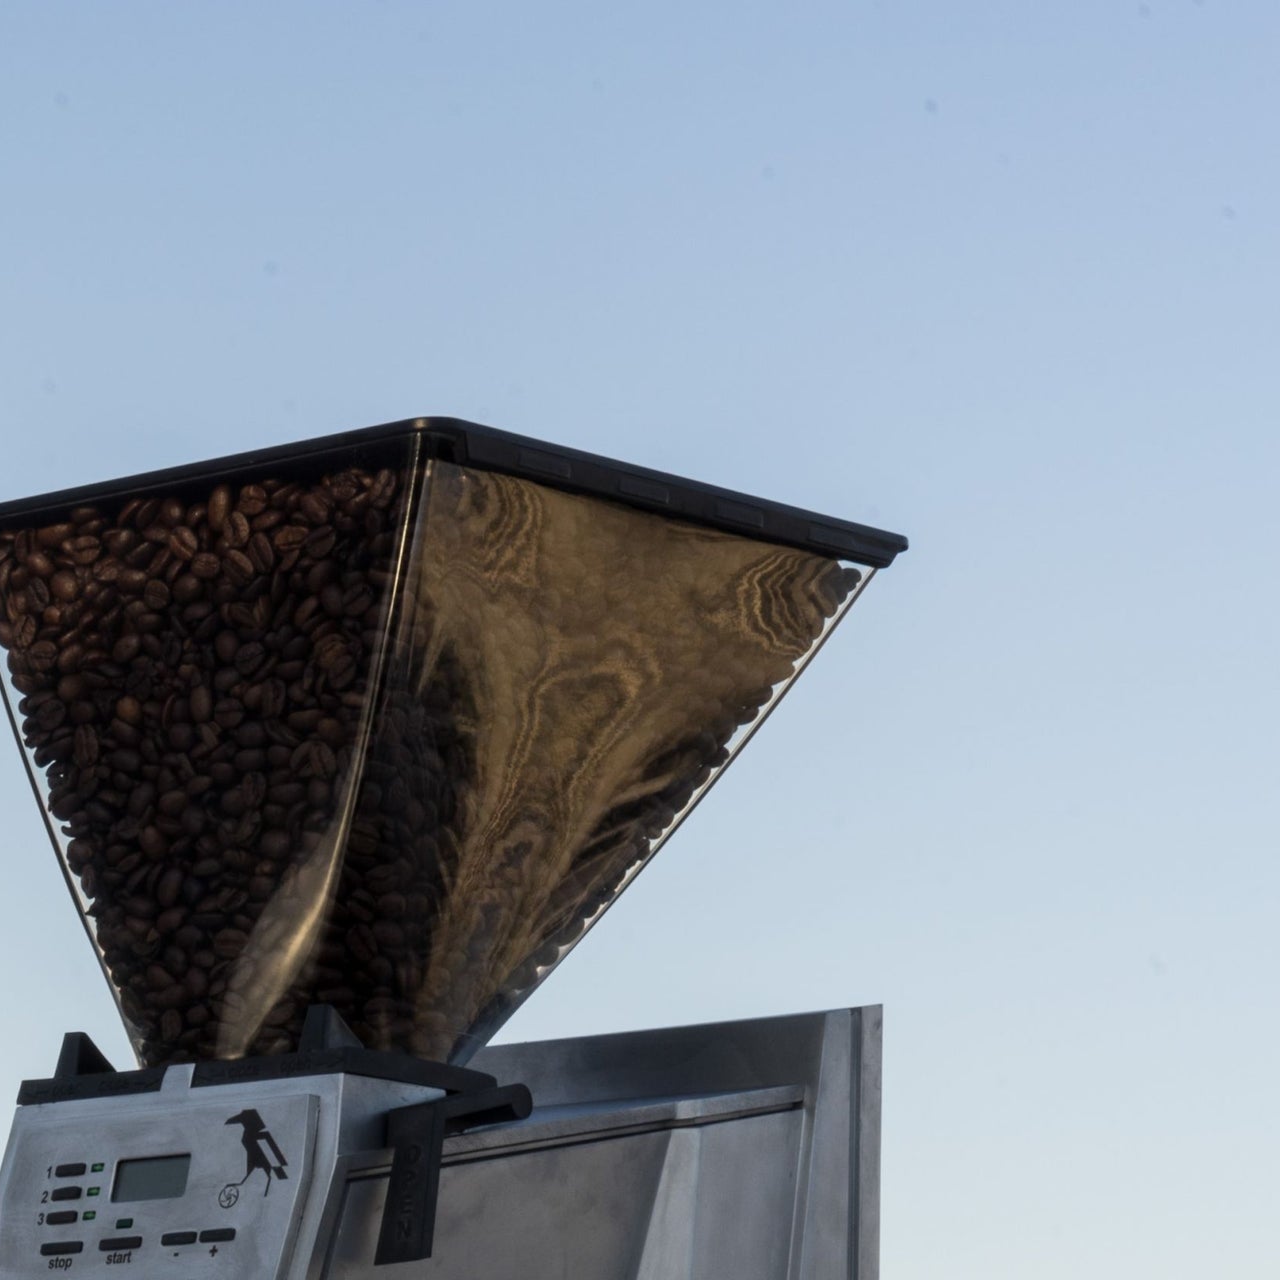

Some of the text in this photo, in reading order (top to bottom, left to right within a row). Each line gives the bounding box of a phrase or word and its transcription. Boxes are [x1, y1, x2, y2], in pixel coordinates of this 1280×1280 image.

[46, 1165, 53, 1179] 1
[40, 1190, 49, 1204] 2
[395, 1144, 422, 1240] OPEN
[37, 1212, 45, 1226] 3
[48, 1256, 73, 1271] stop
[105, 1251, 132, 1265] start
